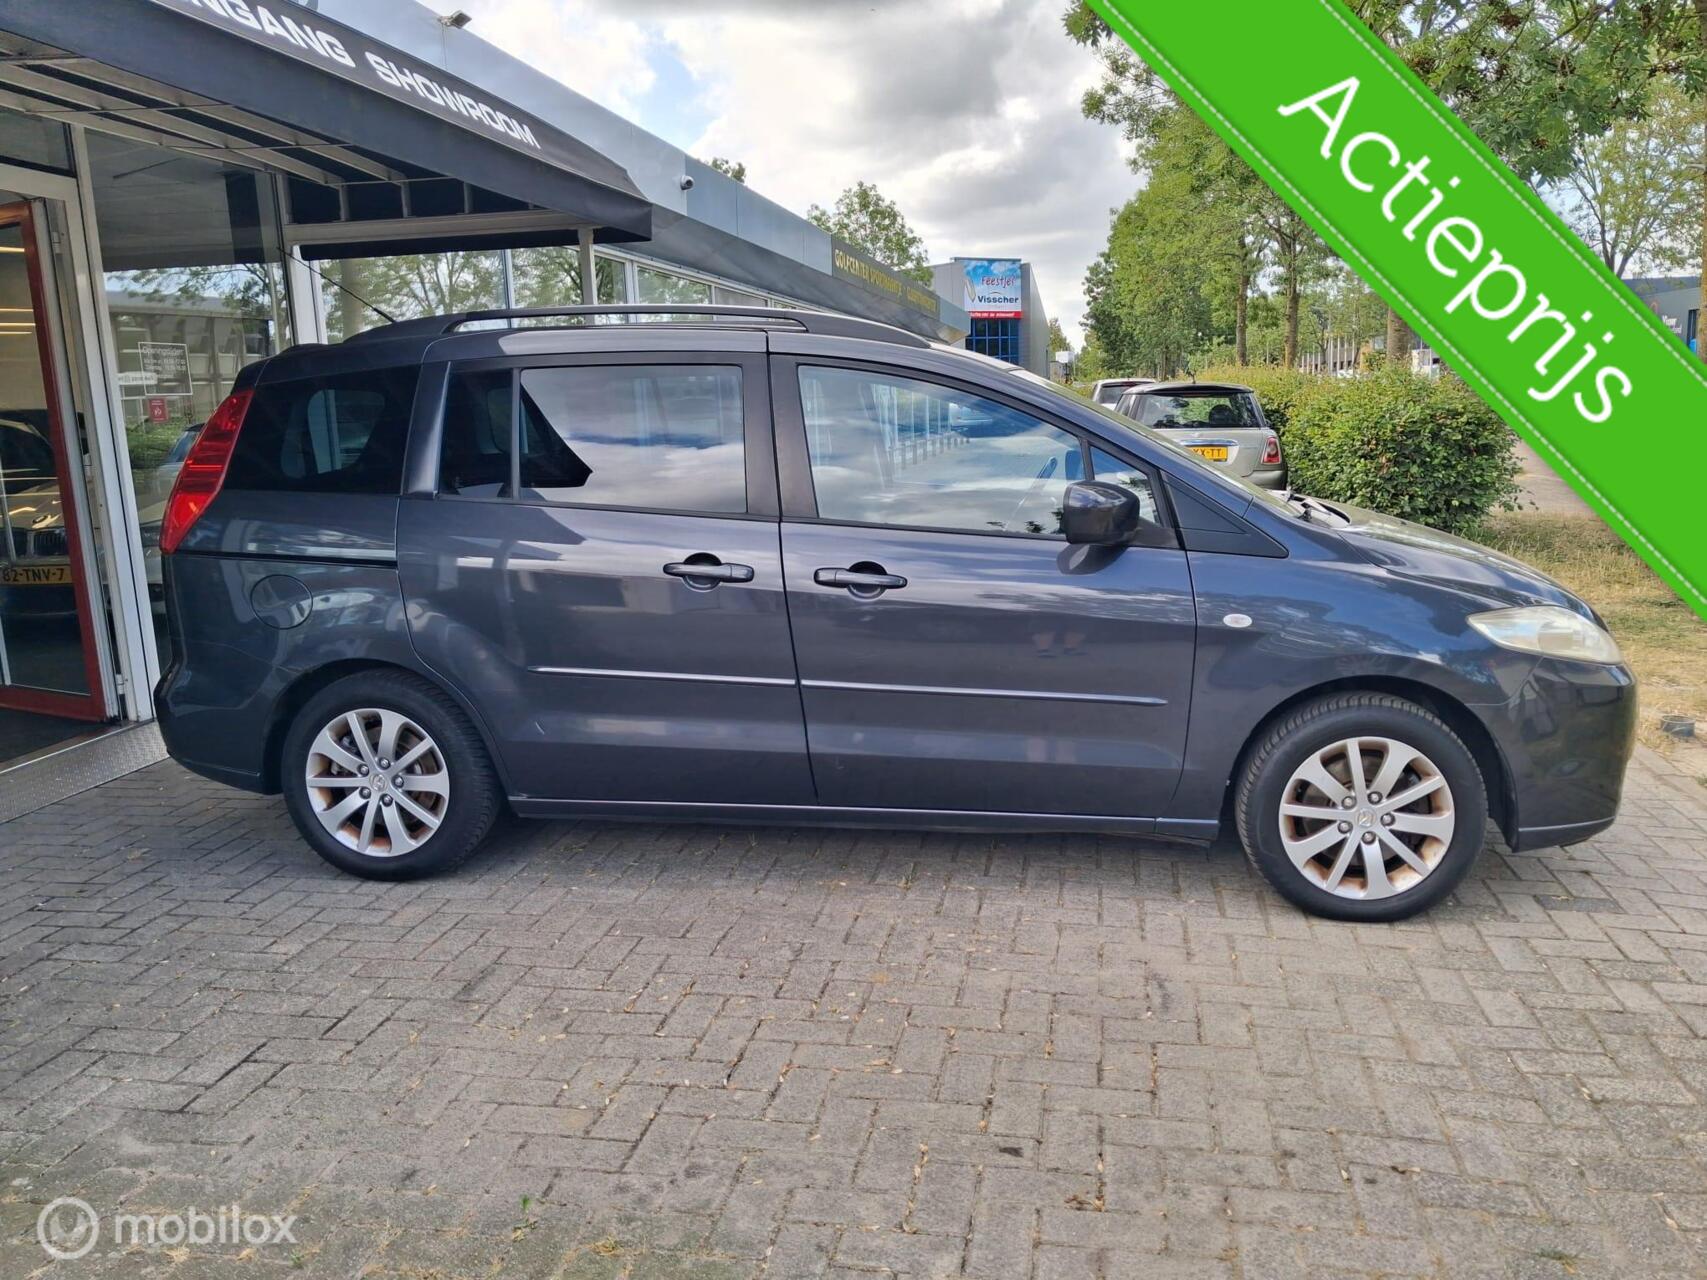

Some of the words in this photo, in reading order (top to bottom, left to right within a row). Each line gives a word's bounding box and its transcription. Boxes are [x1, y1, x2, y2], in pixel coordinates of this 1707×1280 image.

[365, 51, 541, 149] SHOWROOM
[978, 295, 1019, 304] Visscher
[2, 567, 65, 582] 82-TNV-7
